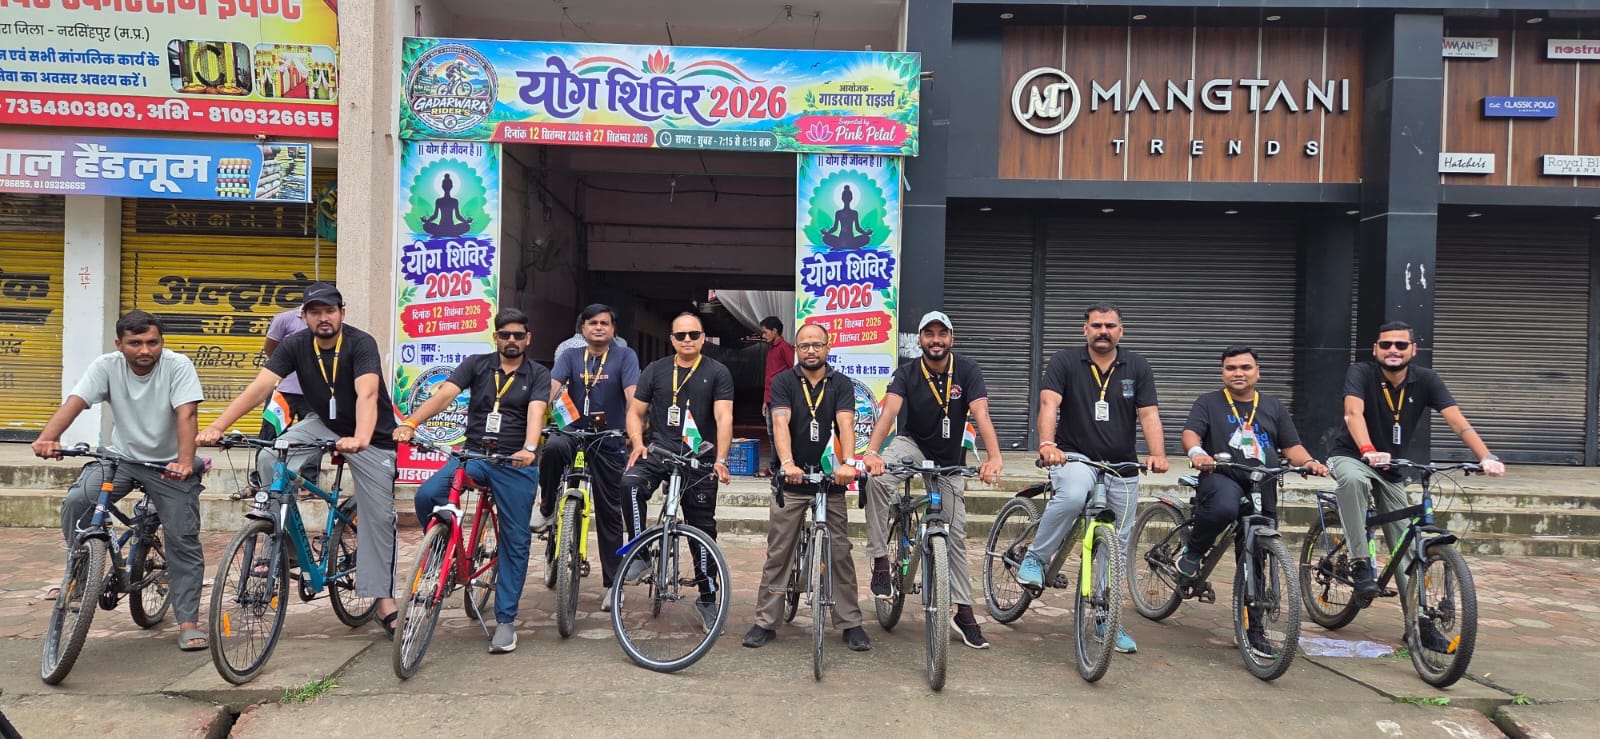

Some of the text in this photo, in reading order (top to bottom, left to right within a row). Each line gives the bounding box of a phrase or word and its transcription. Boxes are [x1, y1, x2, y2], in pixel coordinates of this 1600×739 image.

[14, 21, 44, 35] जिला
[56, 22, 111, 41] नरसिंहपुर
[8, 46, 26, 61] एवं
[28, 47, 56, 62] सभी
[58, 49, 115, 65] मांगलिक
[117, 50, 146, 66] कार्य
[147, 52, 160, 66] के
[20, 71, 37, 83] का
[40, 72, 77, 84] अवसर
[80, 73, 118, 86] अवश्य
[516, 55, 788, 127] योग शिविर 2026
[839, 82, 869, 93] आयोजक
[818, 90, 896, 108] गाडरवारा राइडर्स
[1091, 78, 1350, 114] MANGTANI
[6, 98, 143, 121] 7354803803,
[147, 99, 189, 120] अभि
[208, 107, 334, 127] 8109326655
[413, 96, 488, 114] GADARWARA
[430, 107, 471, 117] RIDER'S
[504, 126, 527, 139] दिनांक
[529, 127, 539, 140] 12
[567, 131, 584, 142] 2026
[585, 129, 592, 141] से
[593, 129, 605, 142] 27
[632, 133, 648, 144] 2026
[719, 136, 733, 147] 7:15
[742, 137, 757, 147] 8:15
[835, 125, 897, 143] Pink Petal
[426, 142, 440, 155] योग
[441, 142, 448, 155] ही
[449, 142, 469, 155] जीवन
[469, 142, 475, 157] है
[1112, 138, 1321, 157] TRENDS
[73, 143, 211, 193] हैंडलूम
[826, 154, 839, 166] योग
[849, 154, 868, 167] जीवन
[1548, 156, 1583, 169] Royal
[164, 203, 197, 227] देश
[406, 240, 490, 275] योग शिविर
[805, 252, 890, 287] योग शिविर
[425, 271, 473, 299] 2026
[825, 283, 873, 311] 2026
[432, 306, 443, 319] 12
[465, 304, 481, 316] 2026
[425, 321, 437, 333] 27
[461, 319, 478, 330] 2026
[833, 318, 843, 330] 12
[865, 316, 882, 327] 2026
[861, 330, 878, 341] 2026
[421, 343, 437, 353] समय
[440, 354, 453, 364] 7:15
[826, 355, 837, 363] मय
[841, 365, 854, 375] 7:15
[863, 365, 876, 375] 8:15
[426, 421, 457, 429] RIDER'S
